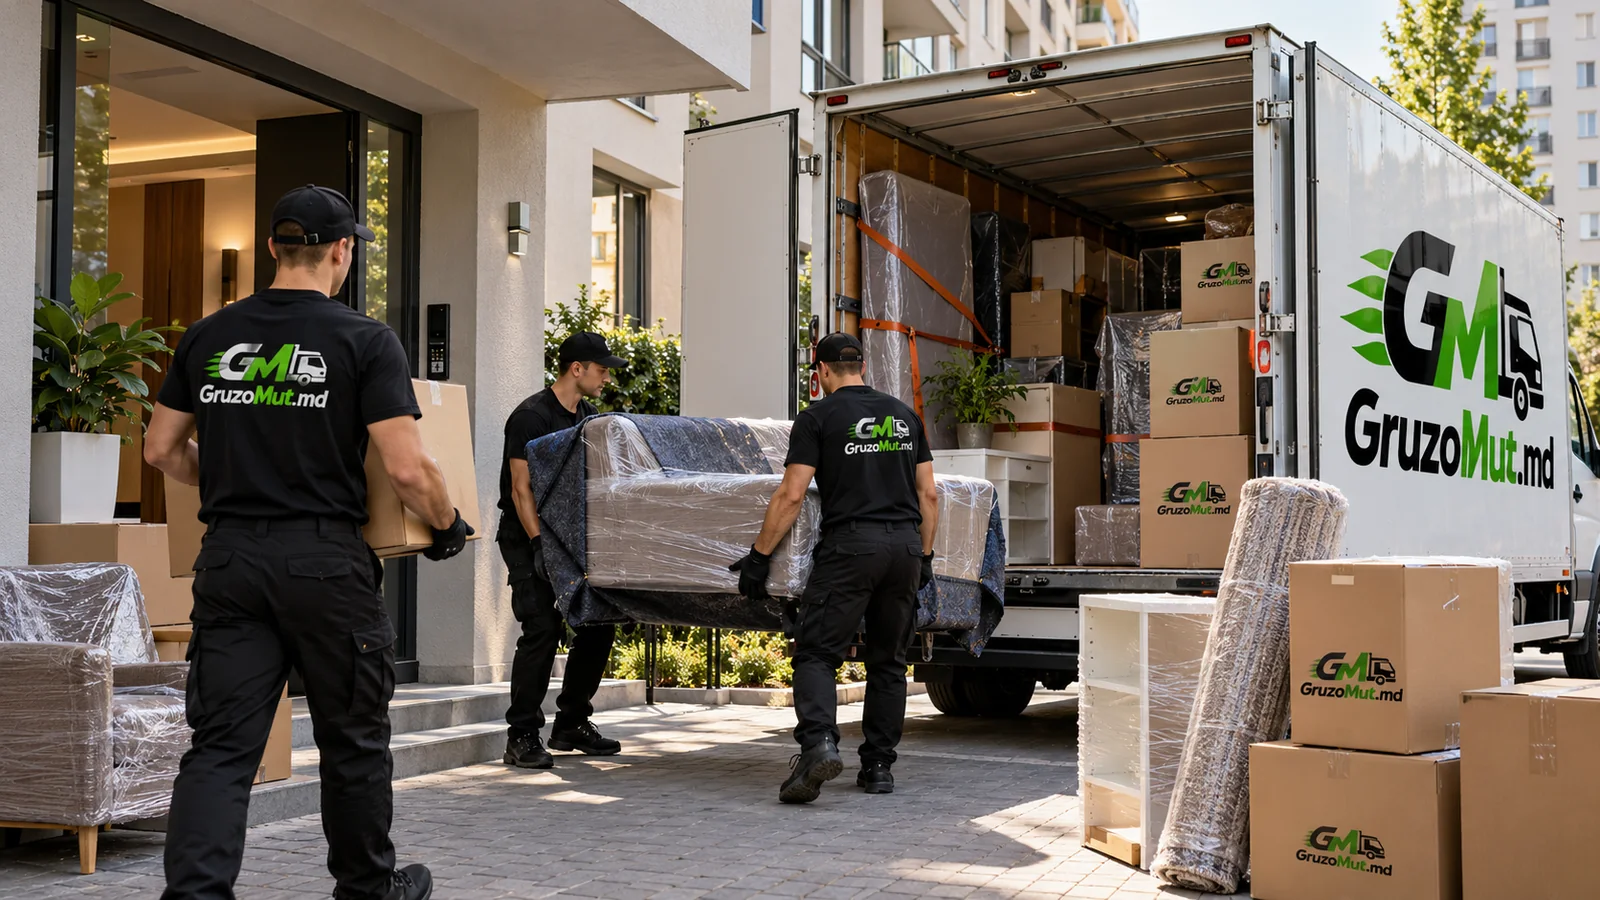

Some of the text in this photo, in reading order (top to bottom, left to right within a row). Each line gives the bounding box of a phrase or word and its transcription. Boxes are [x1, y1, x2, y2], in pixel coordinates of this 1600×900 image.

[1207, 261, 1236, 279] GM
[1383, 230, 1498, 401] GM
[219, 343, 295, 382] GM
[199, 384, 329, 408] GruzoMut.md
[1176, 376, 1207, 395] GM
[1166, 395, 1225, 405] GruzoMut.md
[855, 415, 893, 439] GM
[1345, 387, 1554, 489] GruzoMut.md
[844, 439, 913, 455] GruzoMut.md
[1168, 481, 1207, 503] GM
[1157, 504, 1231, 515] GruzoMut.md
[1316, 652, 1368, 682] GM
[1300, 682, 1403, 702] GruzoMut.md
[1310, 826, 1358, 855] GM
[1296, 849, 1393, 876] GruzoMut.md
